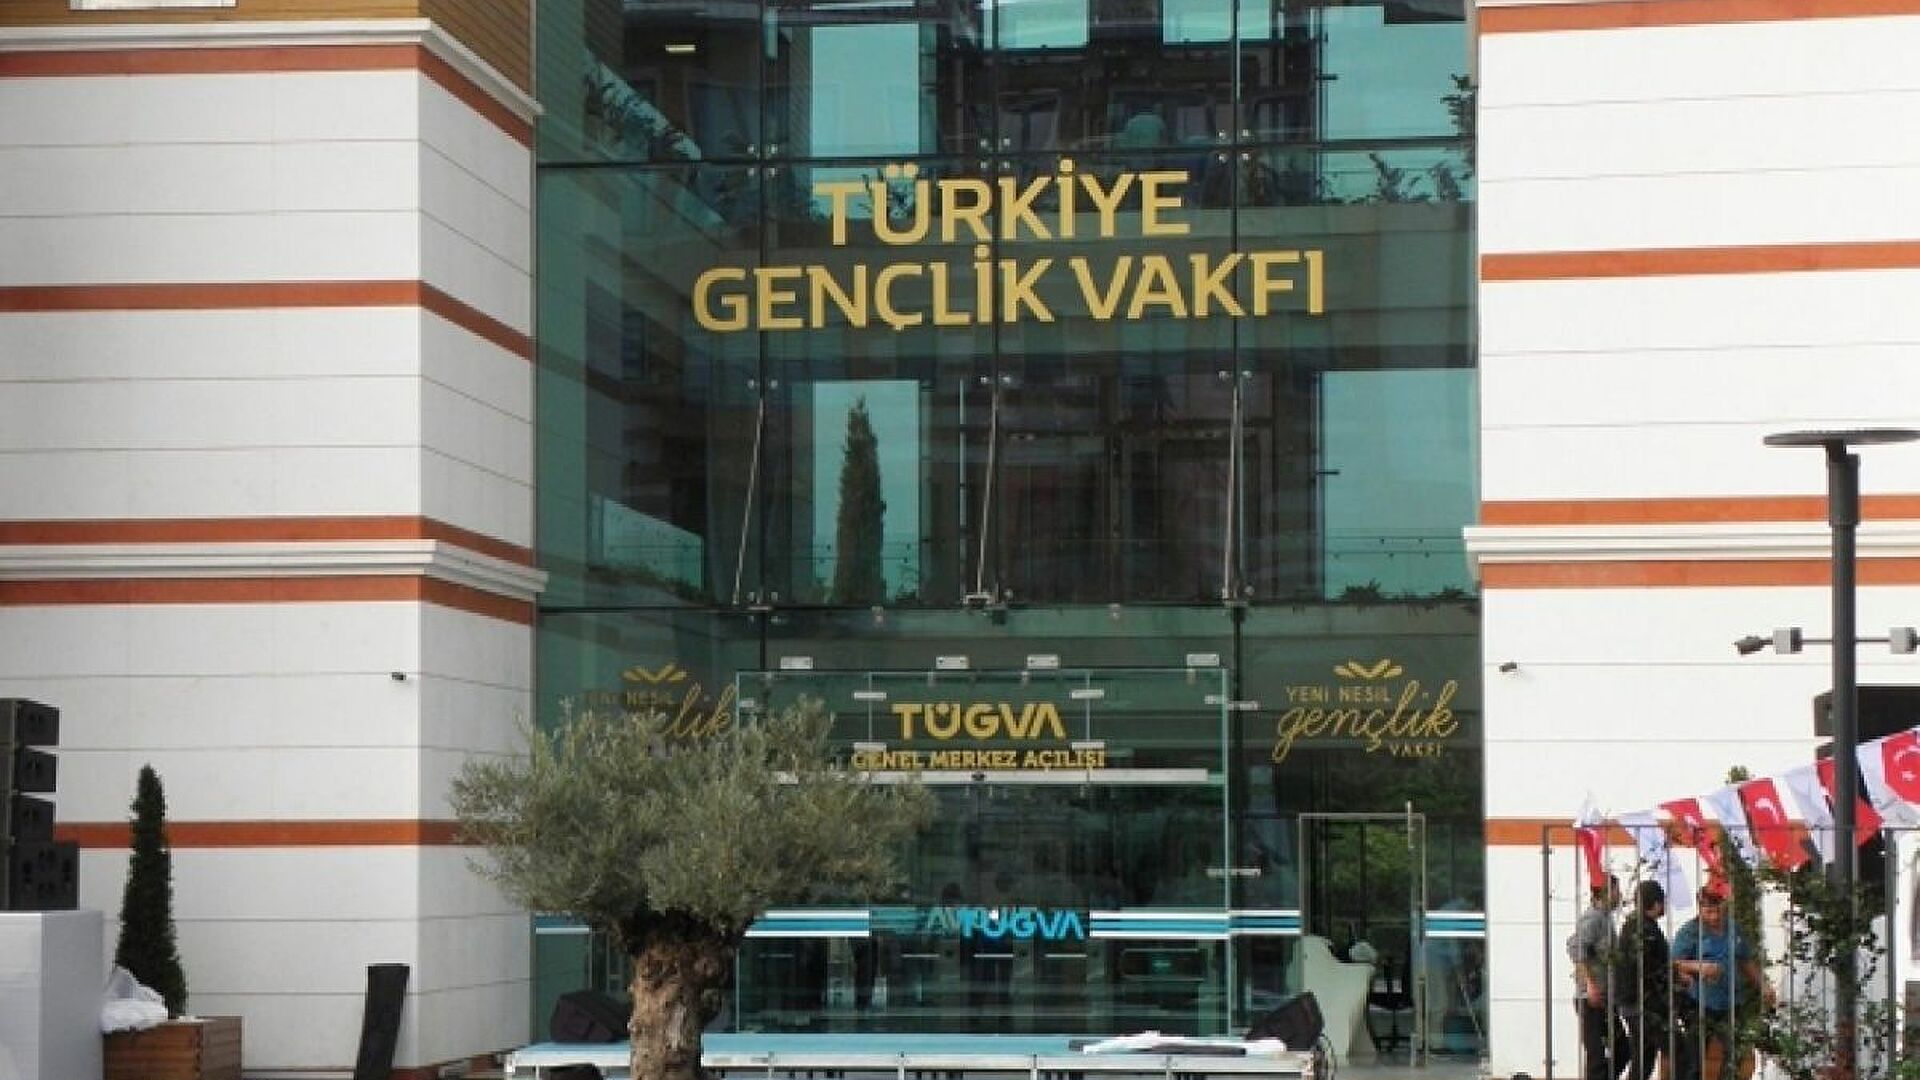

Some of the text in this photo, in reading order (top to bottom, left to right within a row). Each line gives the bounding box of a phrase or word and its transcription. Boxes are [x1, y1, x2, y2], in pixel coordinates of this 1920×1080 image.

[812, 160, 1191, 245] TÜRKİYE
[693, 244, 1324, 331] GENÇLİK VAKFI
[852, 751, 923, 769] GENEL
[930, 751, 1017, 769] MERKEZ
